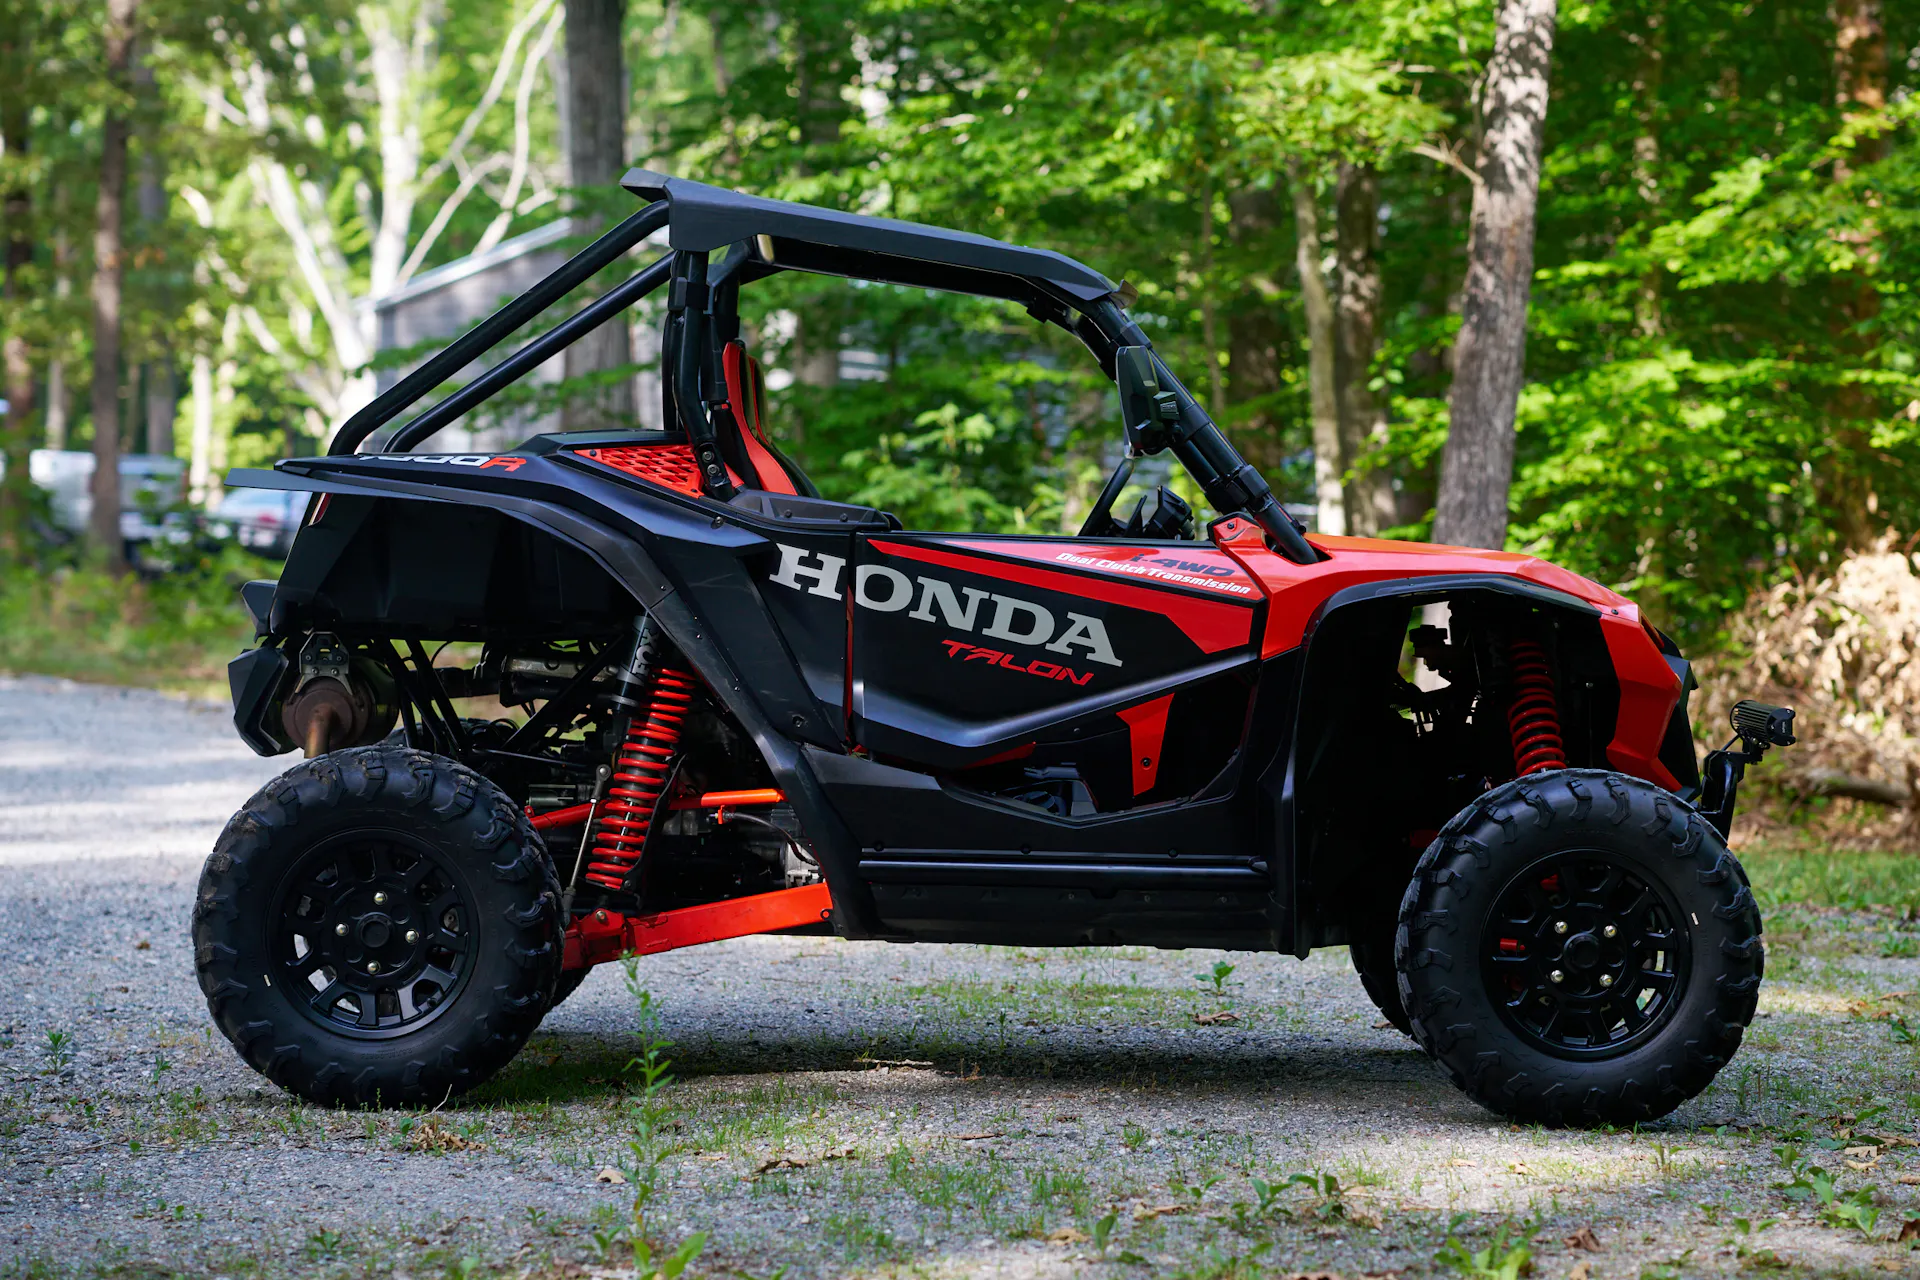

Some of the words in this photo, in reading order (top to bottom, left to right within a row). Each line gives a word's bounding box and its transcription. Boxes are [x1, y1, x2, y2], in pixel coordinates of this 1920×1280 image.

[1055, 552, 1096, 565] Dual
[1095, 559, 1147, 575] Clutch
[1147, 568, 1251, 595] Transmission
[1129, 553, 1236, 577] i-4WD
[769, 542, 1123, 667] HONDA
[631, 628, 660, 677] FOX
[941, 639, 1094, 686] TALON
